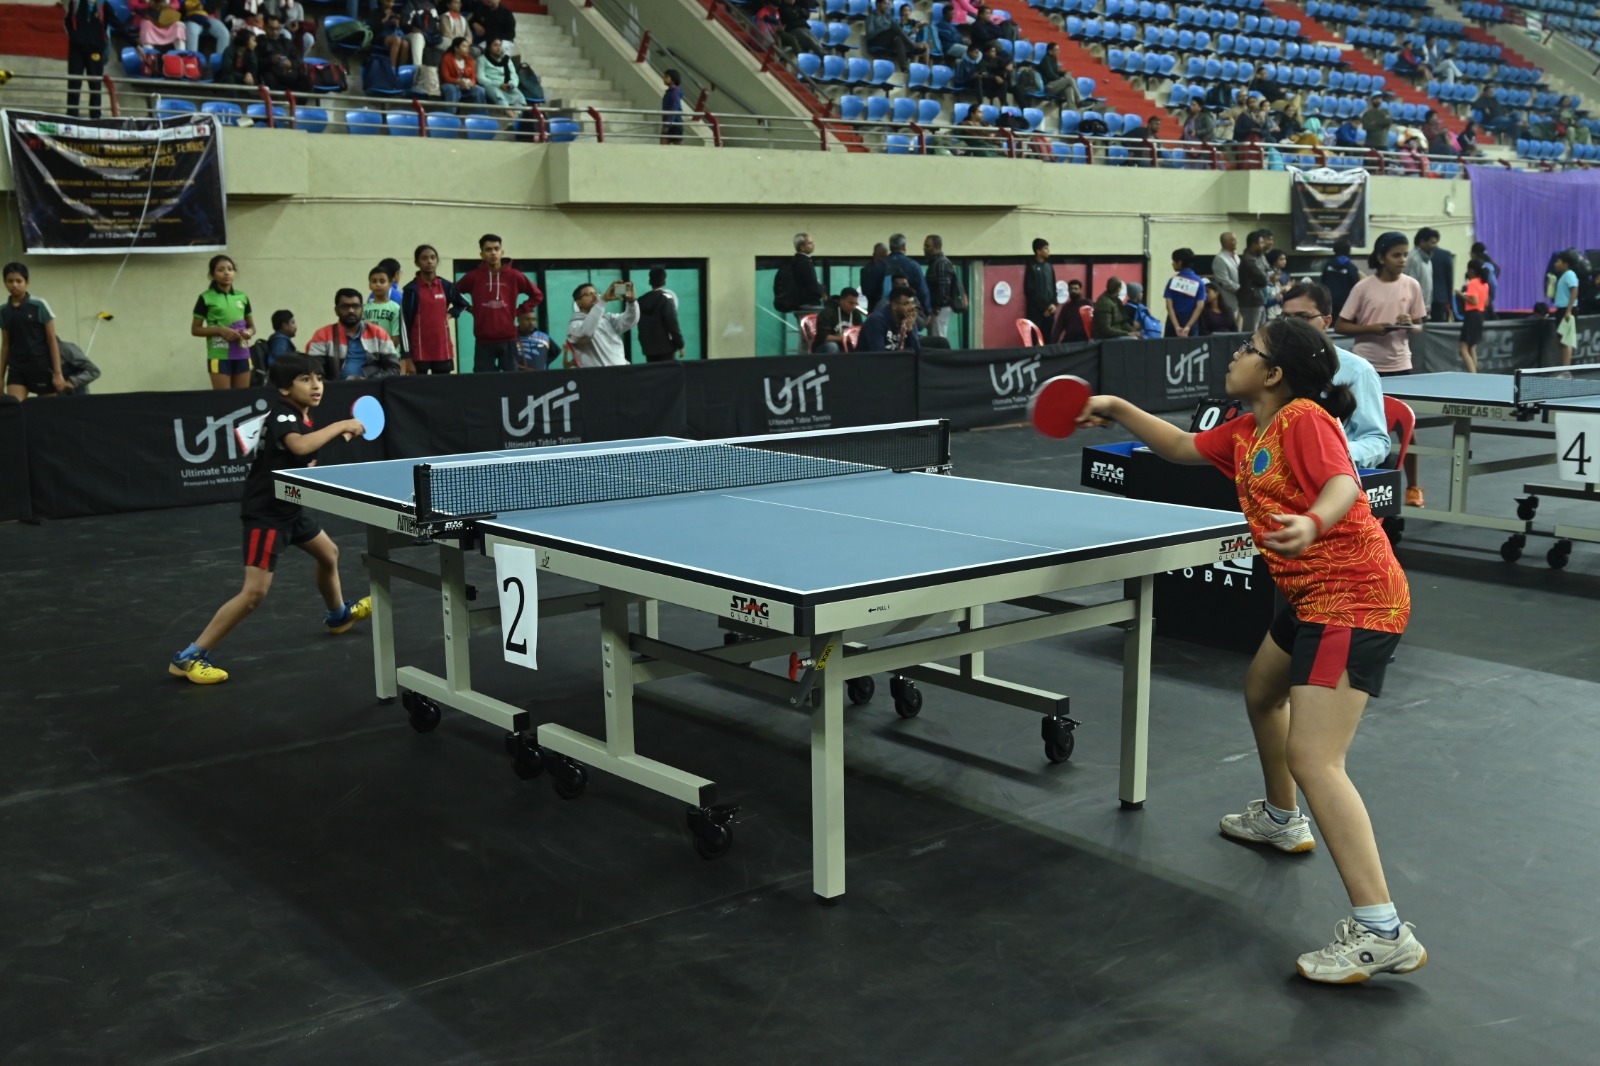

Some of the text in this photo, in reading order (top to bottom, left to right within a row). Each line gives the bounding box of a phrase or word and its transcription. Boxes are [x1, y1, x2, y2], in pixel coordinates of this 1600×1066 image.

[1199, 406, 1220, 431] 0
[1442, 404, 1488, 417] AMERICAS
[504, 436, 582, 449] Ultimate Table Tennis
[1562, 432, 1592, 476] 4
[180, 467, 220, 479] Ultimate
[220, 464, 246, 474] Table
[1091, 461, 1124, 480] STAG
[1370, 500, 1393, 509] LOBAL
[1219, 537, 1252, 554] STAG
[1219, 550, 1252, 560] GLOBAL
[1167, 567, 1252, 590] OBAL
[731, 595, 769, 618] STAG
[503, 576, 527, 655] 2
[731, 612, 769, 627] GLOBAL
